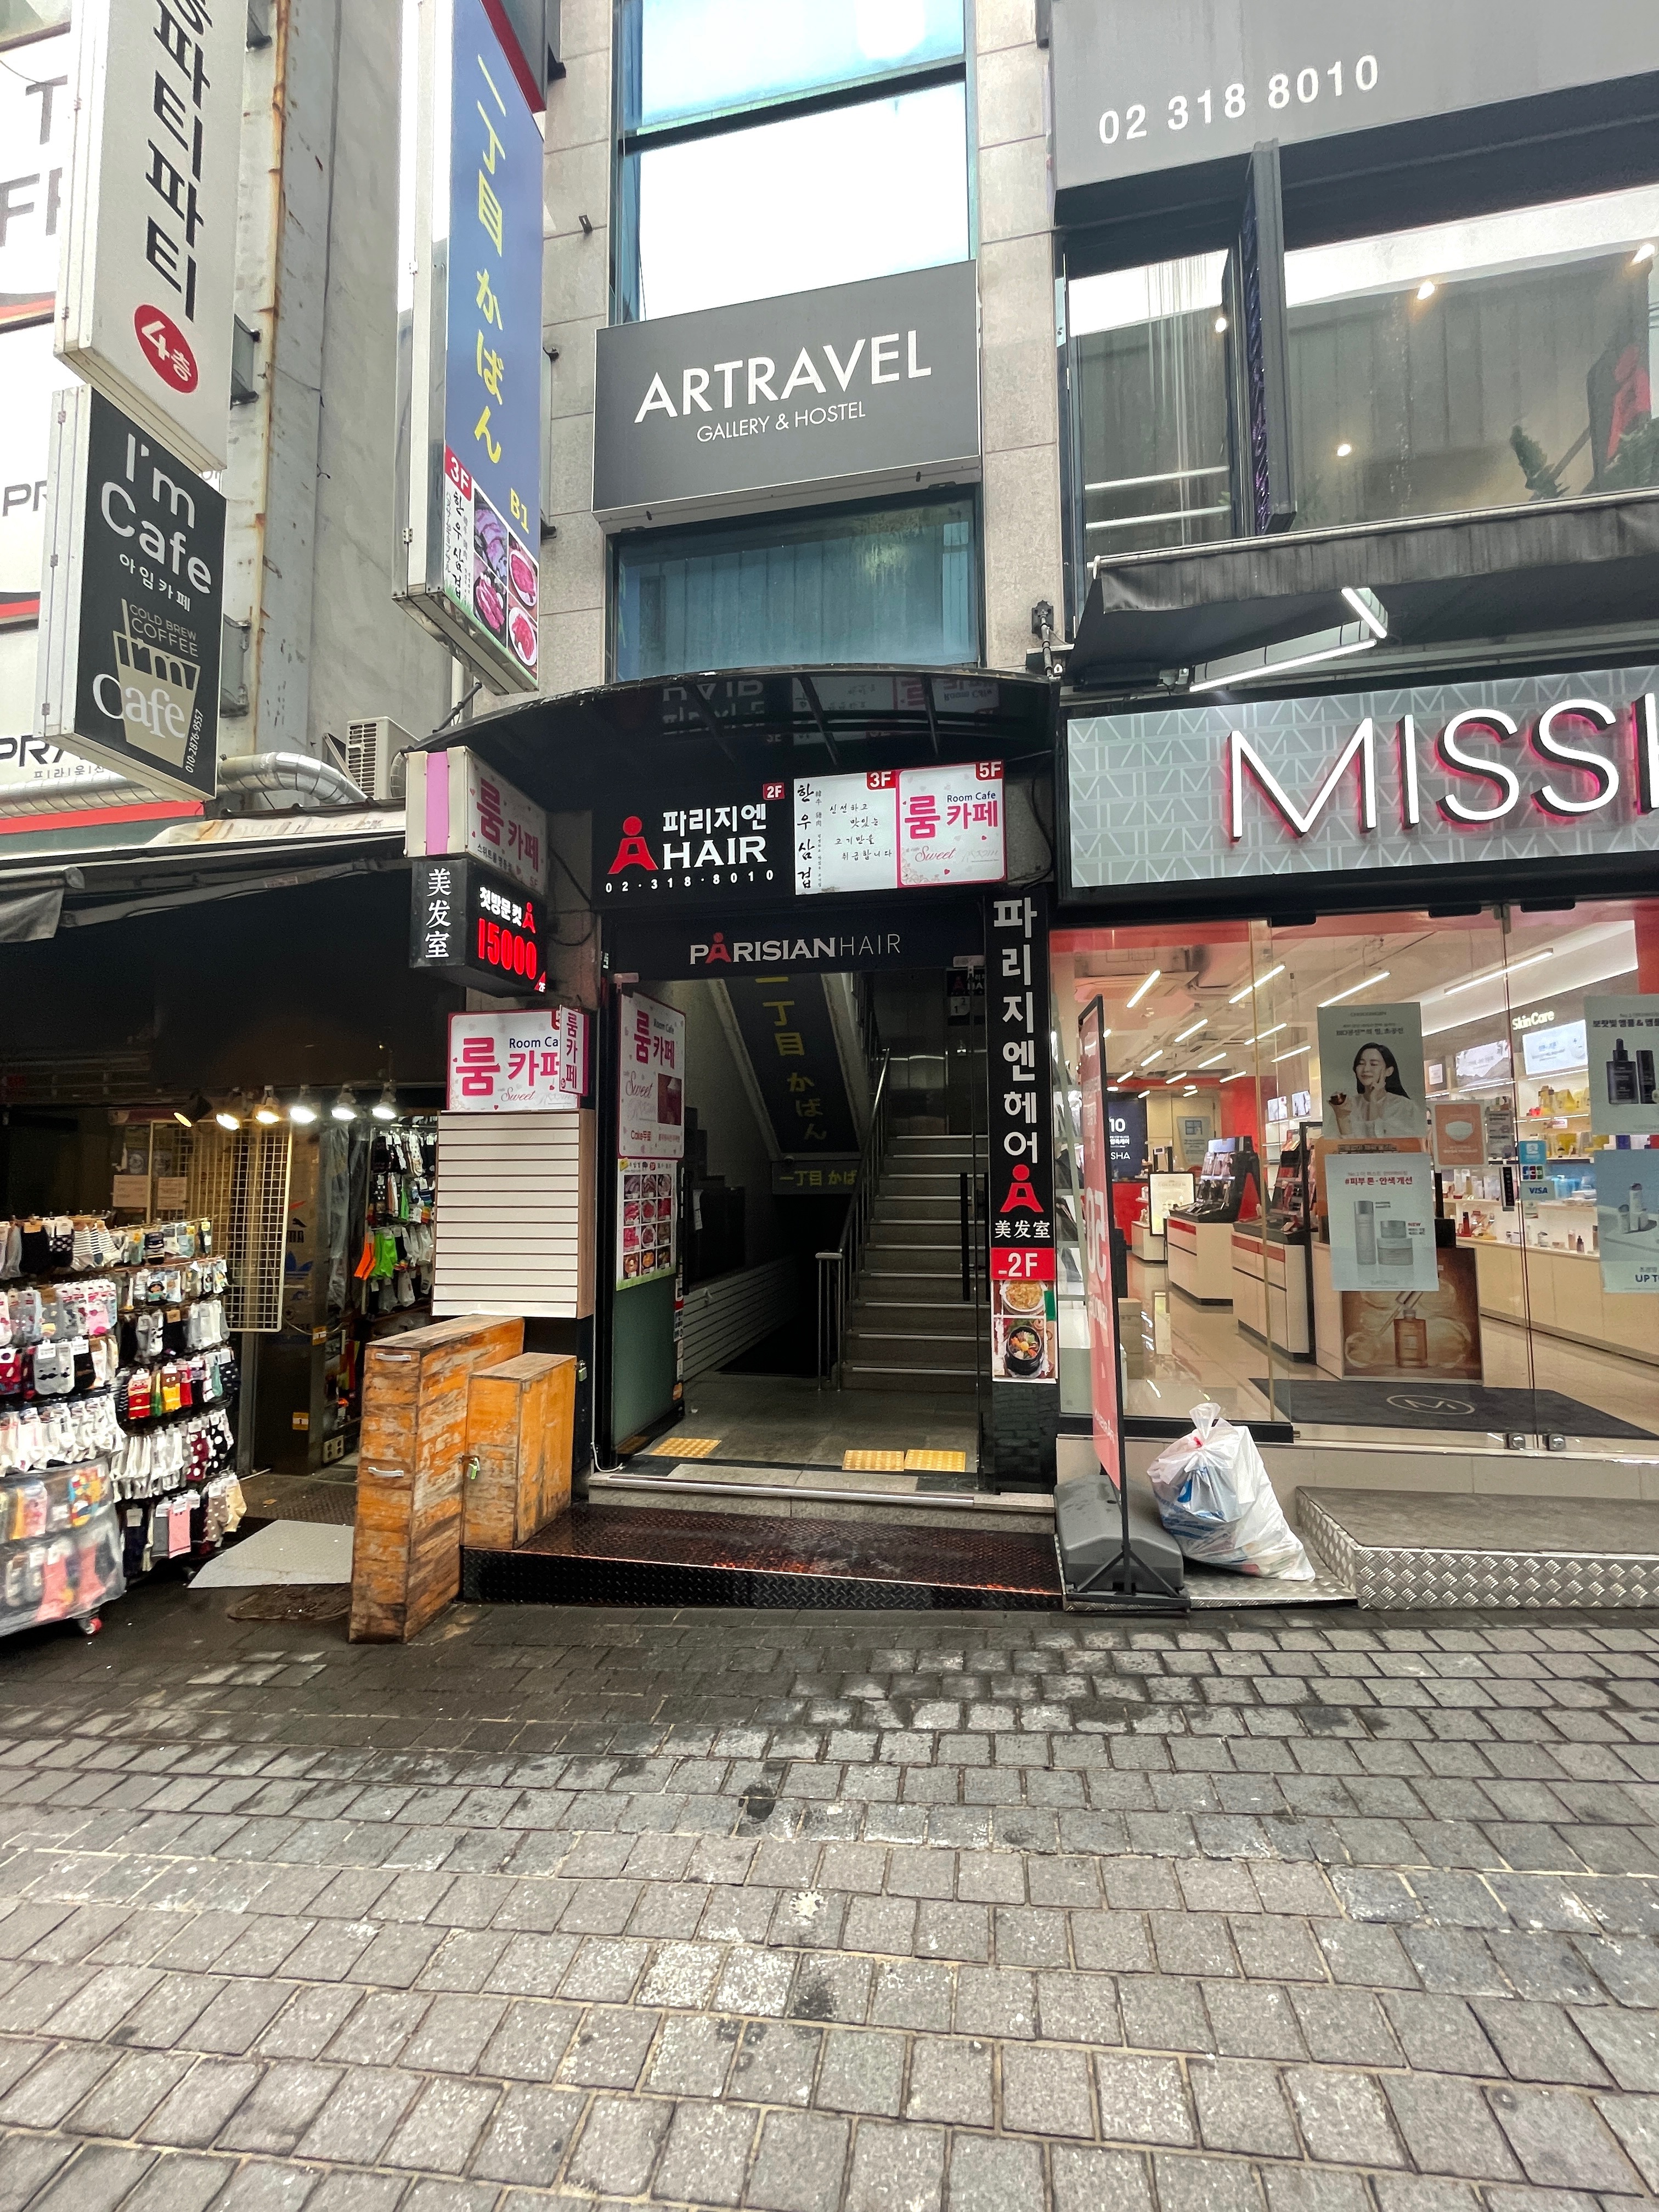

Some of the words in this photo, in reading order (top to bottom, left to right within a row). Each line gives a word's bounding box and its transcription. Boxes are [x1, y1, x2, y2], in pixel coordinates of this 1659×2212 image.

[1099, 104, 1147, 145] 02
[1167, 83, 1246, 131] 318
[1267, 54, 1379, 109] 8010
[145, 0, 213, 323] 파티파티
[634, 330, 932, 424] ARTRAVEL
[696, 415, 768, 443] GALLERY
[775, 414, 790, 430] &
[794, 400, 866, 427] HOSTEL
[126, 433, 195, 529] I'm
[450, 455, 470, 492] 3F
[510, 487, 529, 534] B1
[101, 481, 211, 594] Cafe
[129, 604, 162, 625] COLD
[166, 619, 196, 641] BREW
[131, 617, 199, 657] COFFEE
[92, 673, 185, 739] Cafe
[185, 708, 204, 774] 010-2876-9557
[869, 771, 891, 788] 3F
[979, 761, 1002, 778] 5F
[766, 785, 783, 799] 2F
[946, 794, 973, 803] Room
[975, 791, 996, 801] Cafe
[662, 803, 768, 837] 파리지엔
[663, 835, 767, 871] HAIR
[915, 845, 956, 863] Sweet
[424, 867, 452, 960] 美发室
[478, 917, 537, 980] 15000
[509, 1038, 541, 1048] Room
[544, 1036, 558, 1047] Ca
[500, 1087, 536, 1102] Sweet
[994, 1220, 1051, 1239] 美发室
[1635, 1274, 1650, 1283] UP
[1651, 1274, 1659, 1283] T
